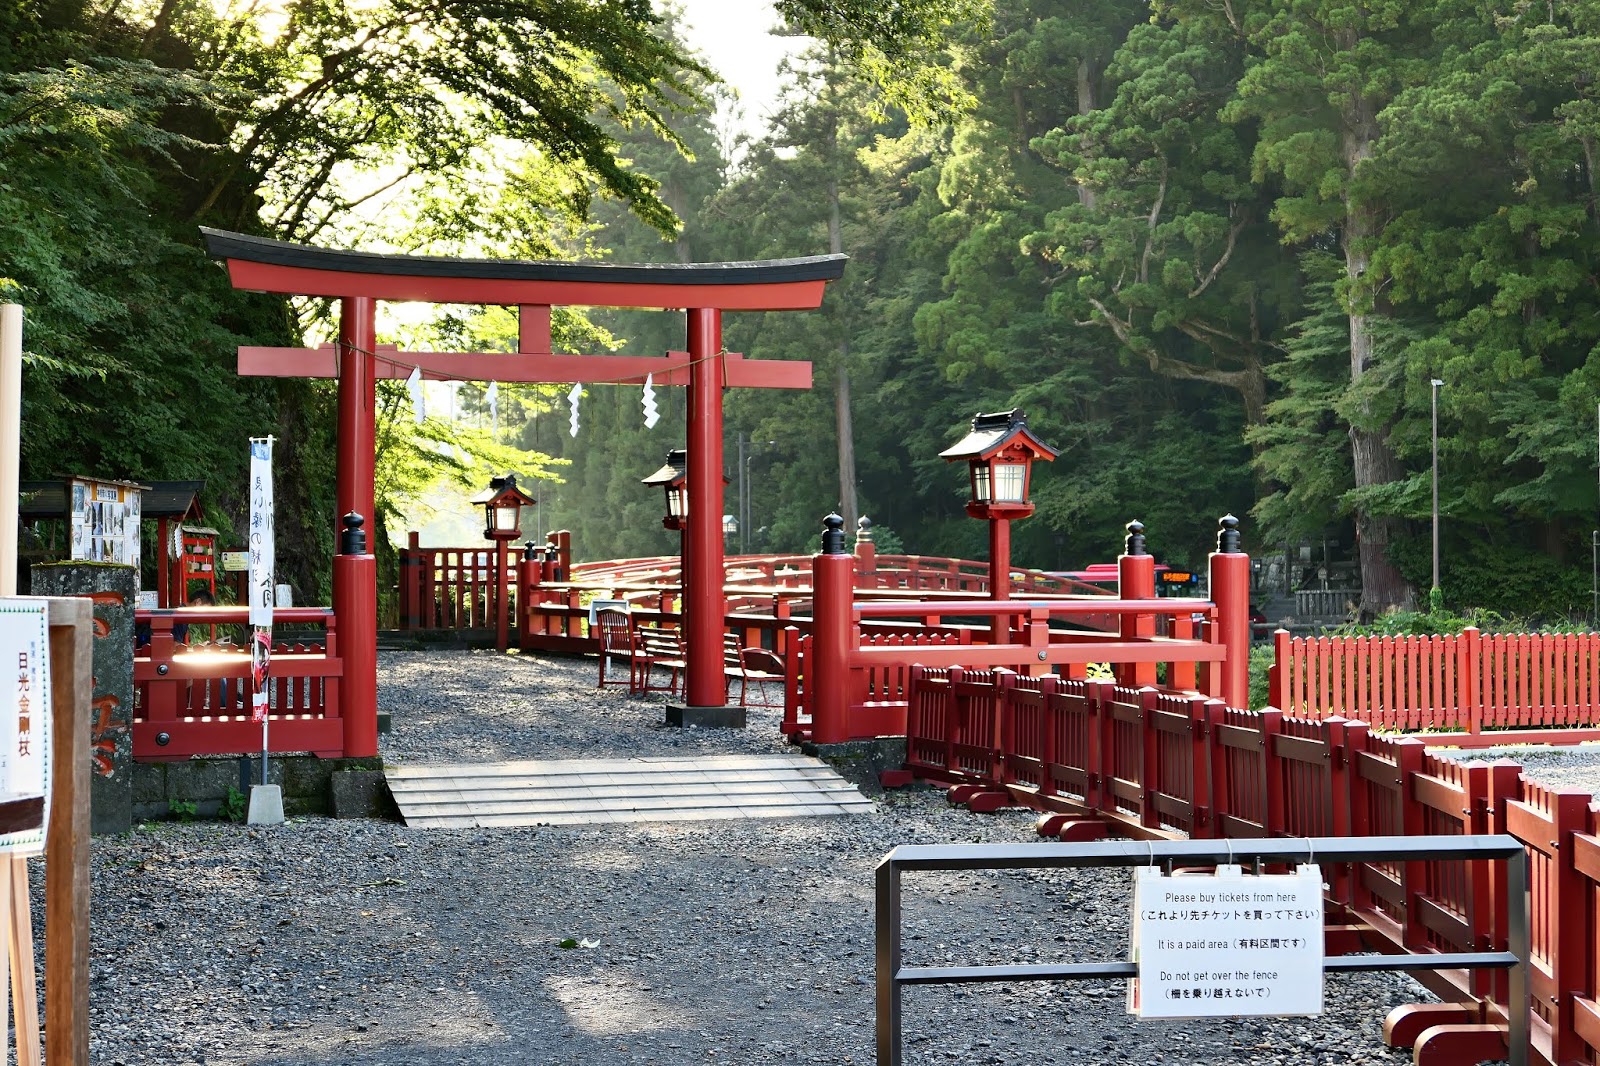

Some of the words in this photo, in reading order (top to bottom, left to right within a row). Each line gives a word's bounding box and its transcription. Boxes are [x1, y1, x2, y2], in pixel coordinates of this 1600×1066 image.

[1165, 892, 1196, 903] Please
[1199, 892, 1216, 904] buy
[1219, 892, 1250, 903] tickets
[1253, 892, 1274, 902] from
[1276, 892, 1297, 902] here
[1158, 939, 1165, 950] It
[1167, 939, 1175, 949] is
[1177, 941, 1183, 949] a
[1185, 939, 1206, 950] paid
[1208, 940, 1228, 949] area
[1160, 971, 1172, 981] Do
[1175, 971, 1190, 981] not
[1193, 971, 1209, 982] get
[1211, 972, 1232, 980] over
[1235, 970, 1250, 980] the
[1252, 970, 1278, 980] fence
